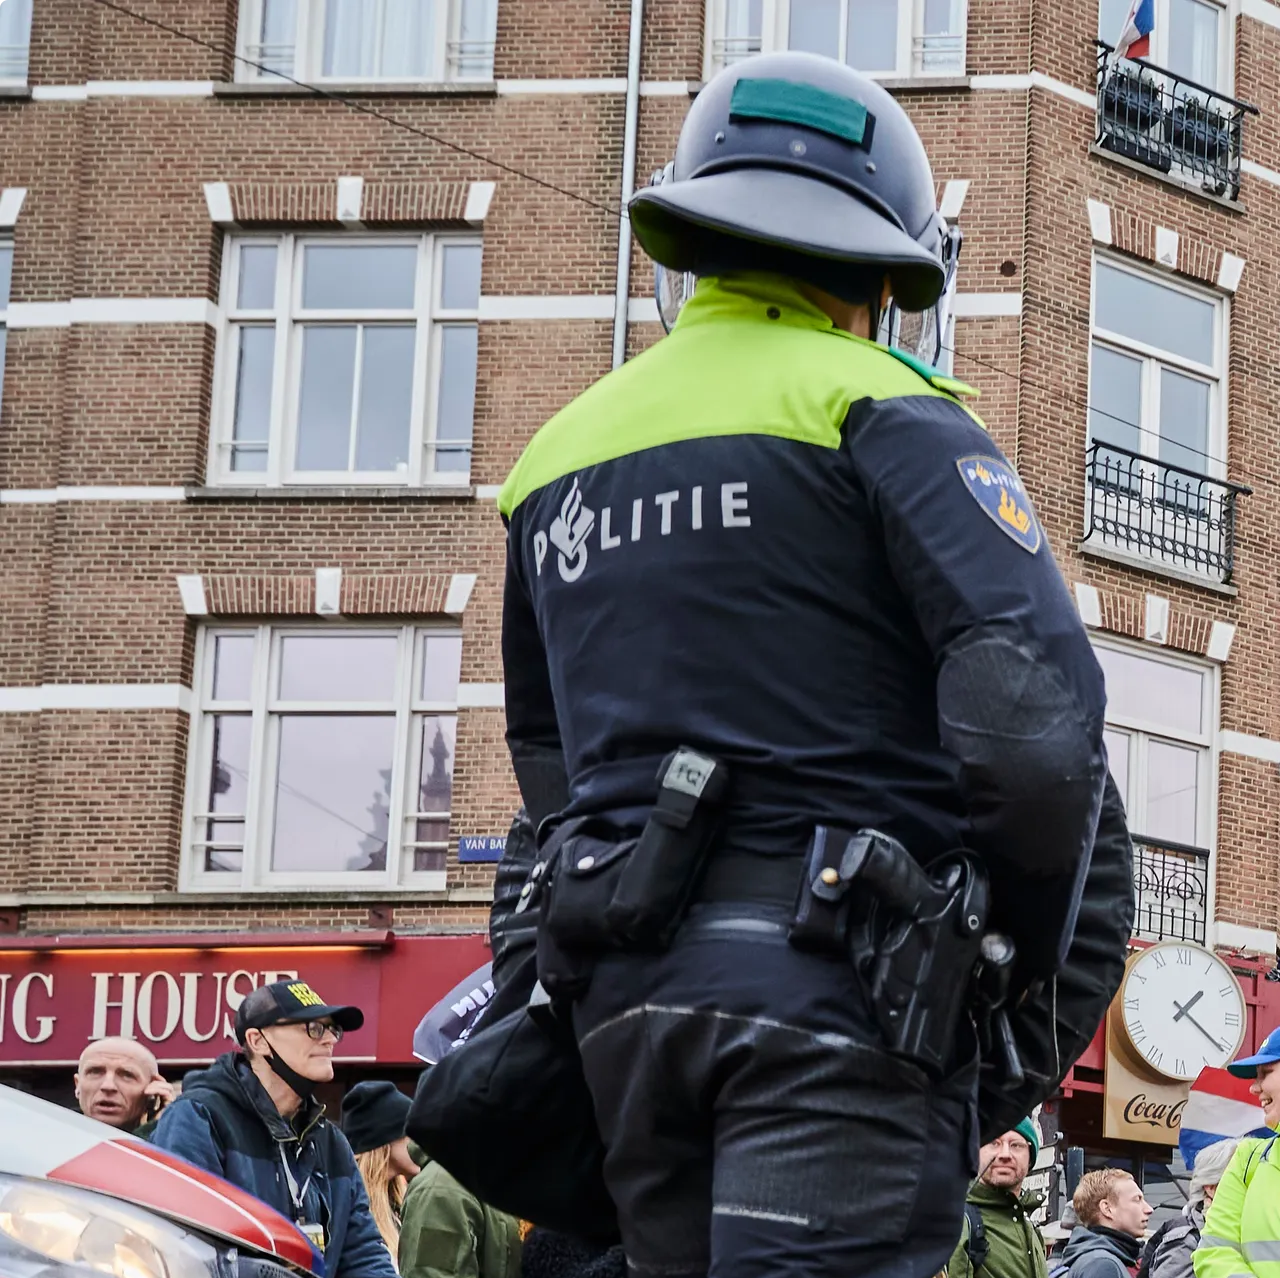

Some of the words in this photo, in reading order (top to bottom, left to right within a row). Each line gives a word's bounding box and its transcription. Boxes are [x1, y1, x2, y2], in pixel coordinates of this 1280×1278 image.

[533, 478, 751, 583] POLITIE
[465, 839, 486, 850] VAN
[0, 972, 56, 1043] G
[88, 970, 298, 1043] HOUS
